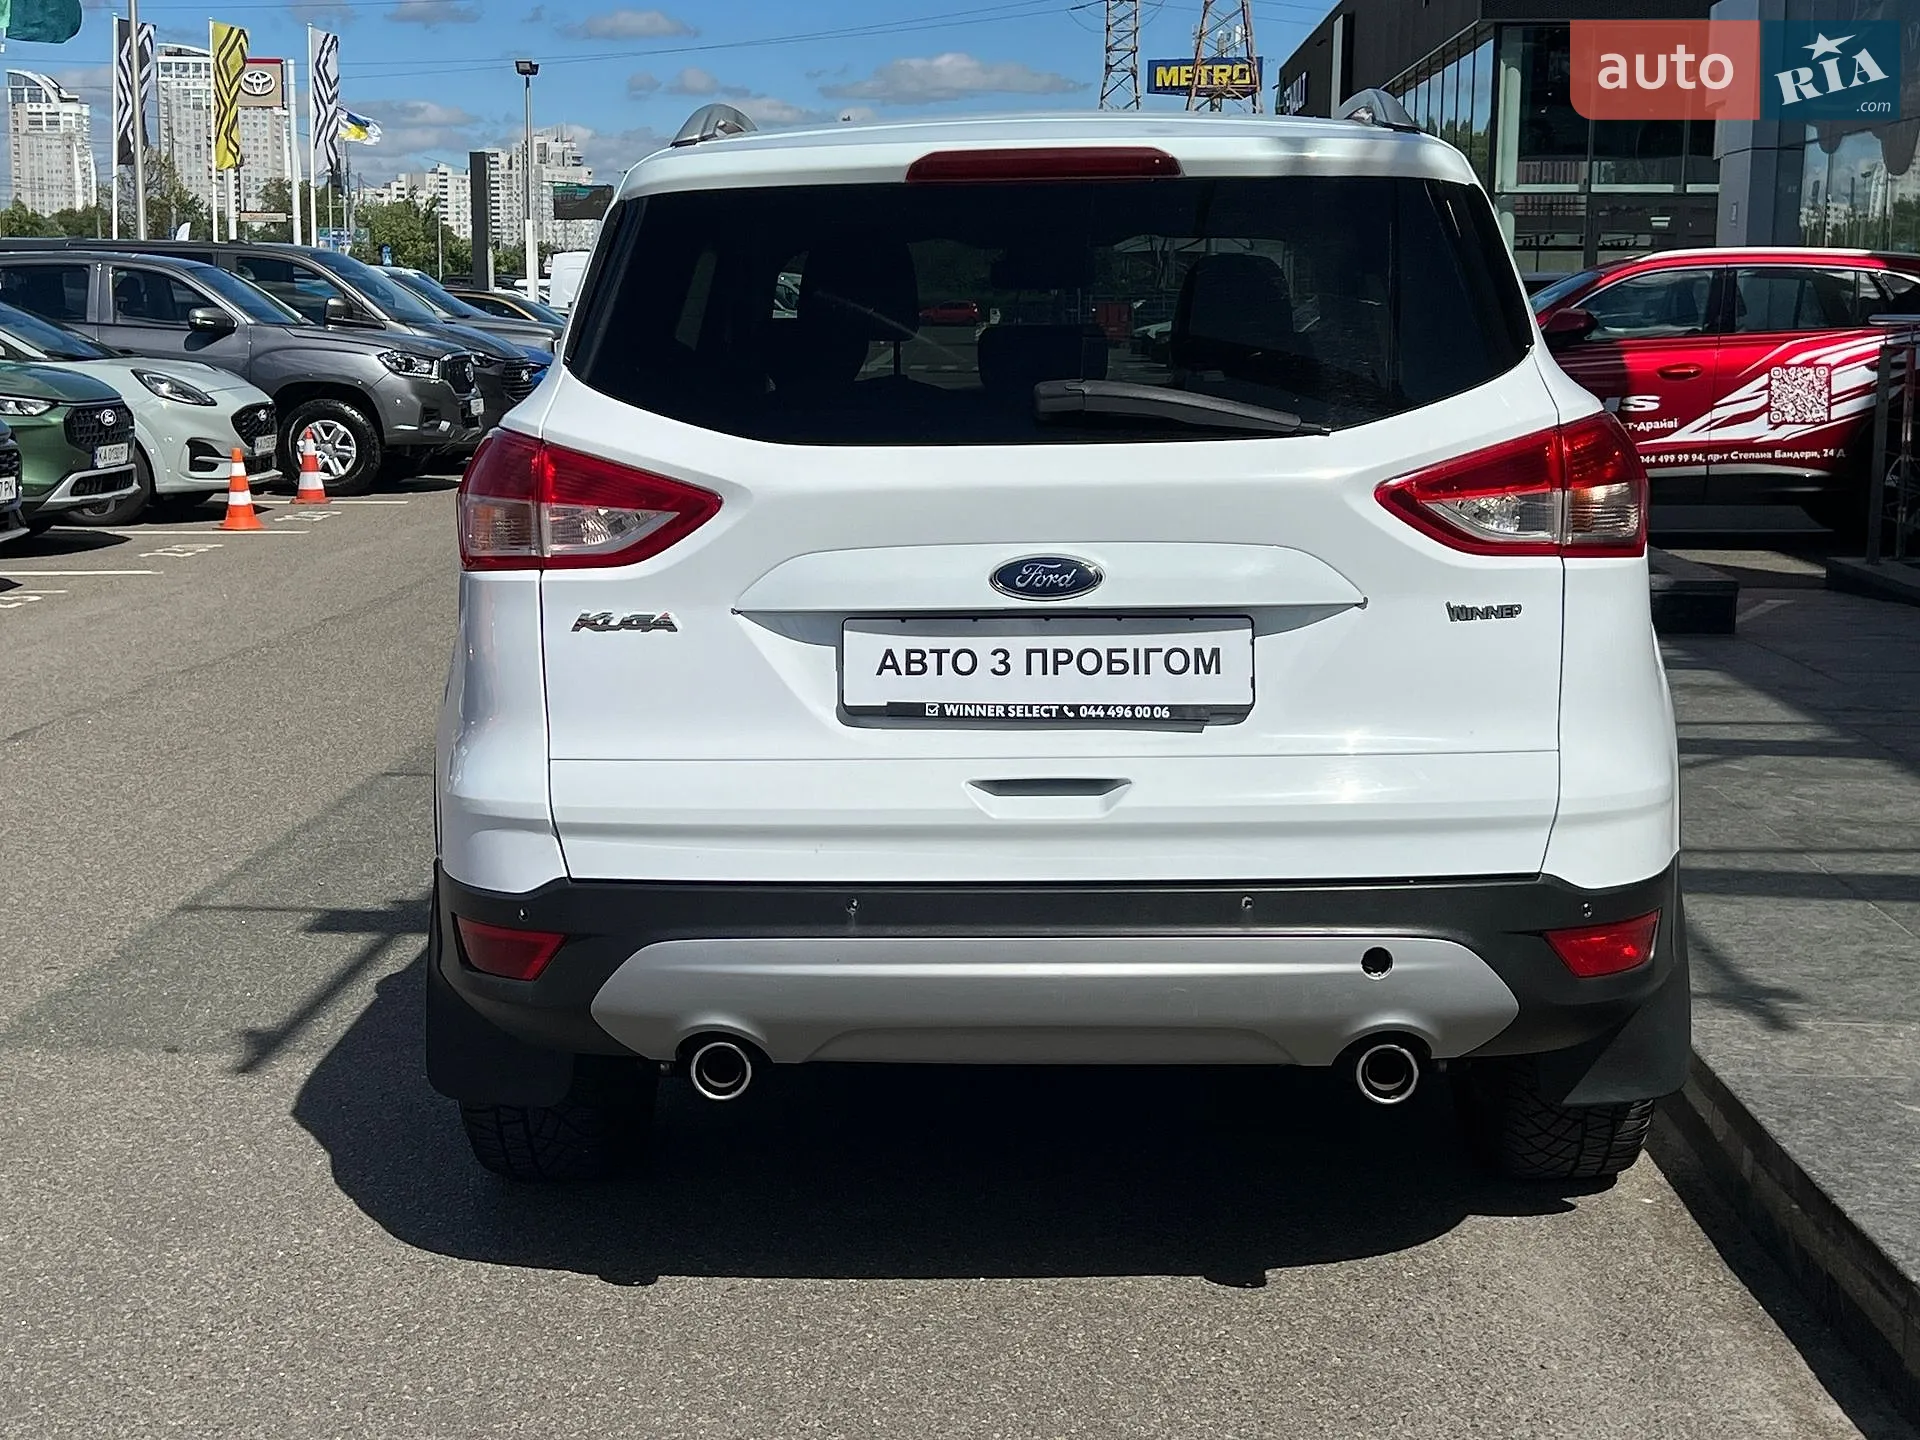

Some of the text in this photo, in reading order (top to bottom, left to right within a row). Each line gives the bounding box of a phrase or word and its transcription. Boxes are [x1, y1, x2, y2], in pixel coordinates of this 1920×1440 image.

[1155, 64, 1251, 87] METRO
[1658, 454, 1675, 463] 499
[1677, 454, 1689, 462] 99
[1730, 451, 1772, 460] Степана
[1822, 448, 1834, 457] 24
[1015, 563, 1077, 588] Ford
[571, 612, 678, 632] KUGA
[875, 648, 978, 676] АВТО
[1025, 647, 1221, 675] ПРОБІГОМ
[944, 703, 1170, 718] WINNER SELECT 044 496 00 06
